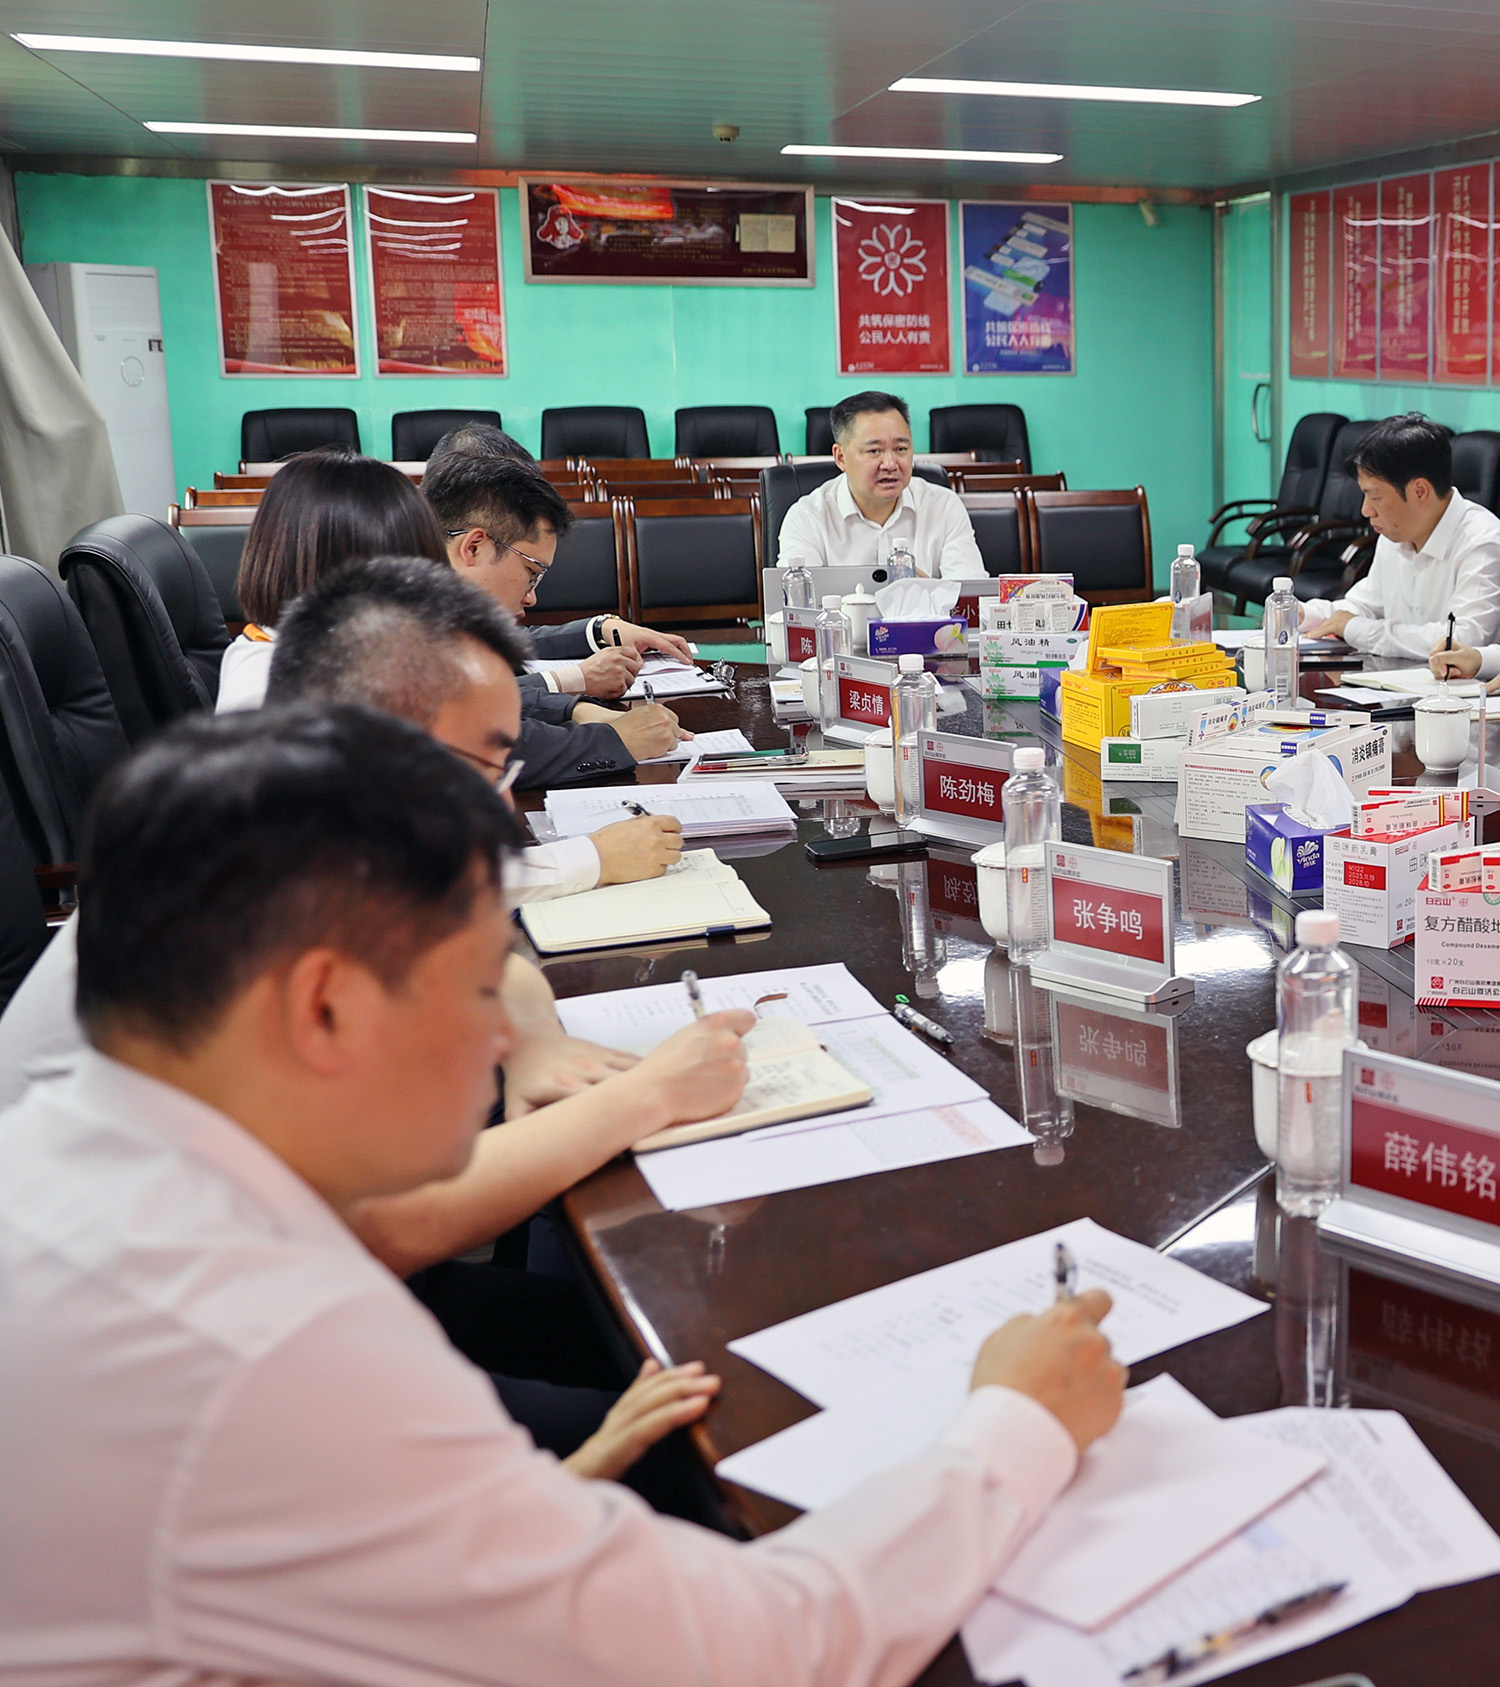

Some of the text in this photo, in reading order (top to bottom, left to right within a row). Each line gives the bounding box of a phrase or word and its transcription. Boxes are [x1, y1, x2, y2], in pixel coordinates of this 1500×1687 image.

[858, 314, 931, 328] 共筑保密防线
[859, 330, 931, 345] 公民人人有责
[800, 637, 814, 654] 陈
[1011, 638, 1050, 646] 风油精
[849, 690, 884, 715] 梁贞情
[1352, 737, 1386, 765] 消炎镇痛膏
[940, 775, 995, 807] 陈劲梅
[1333, 841, 1378, 856] 曲咪新乳膏
[1297, 852, 1320, 865] Vinda
[1425, 897, 1452, 906] 白云山
[1073, 899, 1143, 940] 张争鸣
[1441, 941, 1474, 950] Compound
[1384, 1131, 1496, 1203] 薛伟铭
